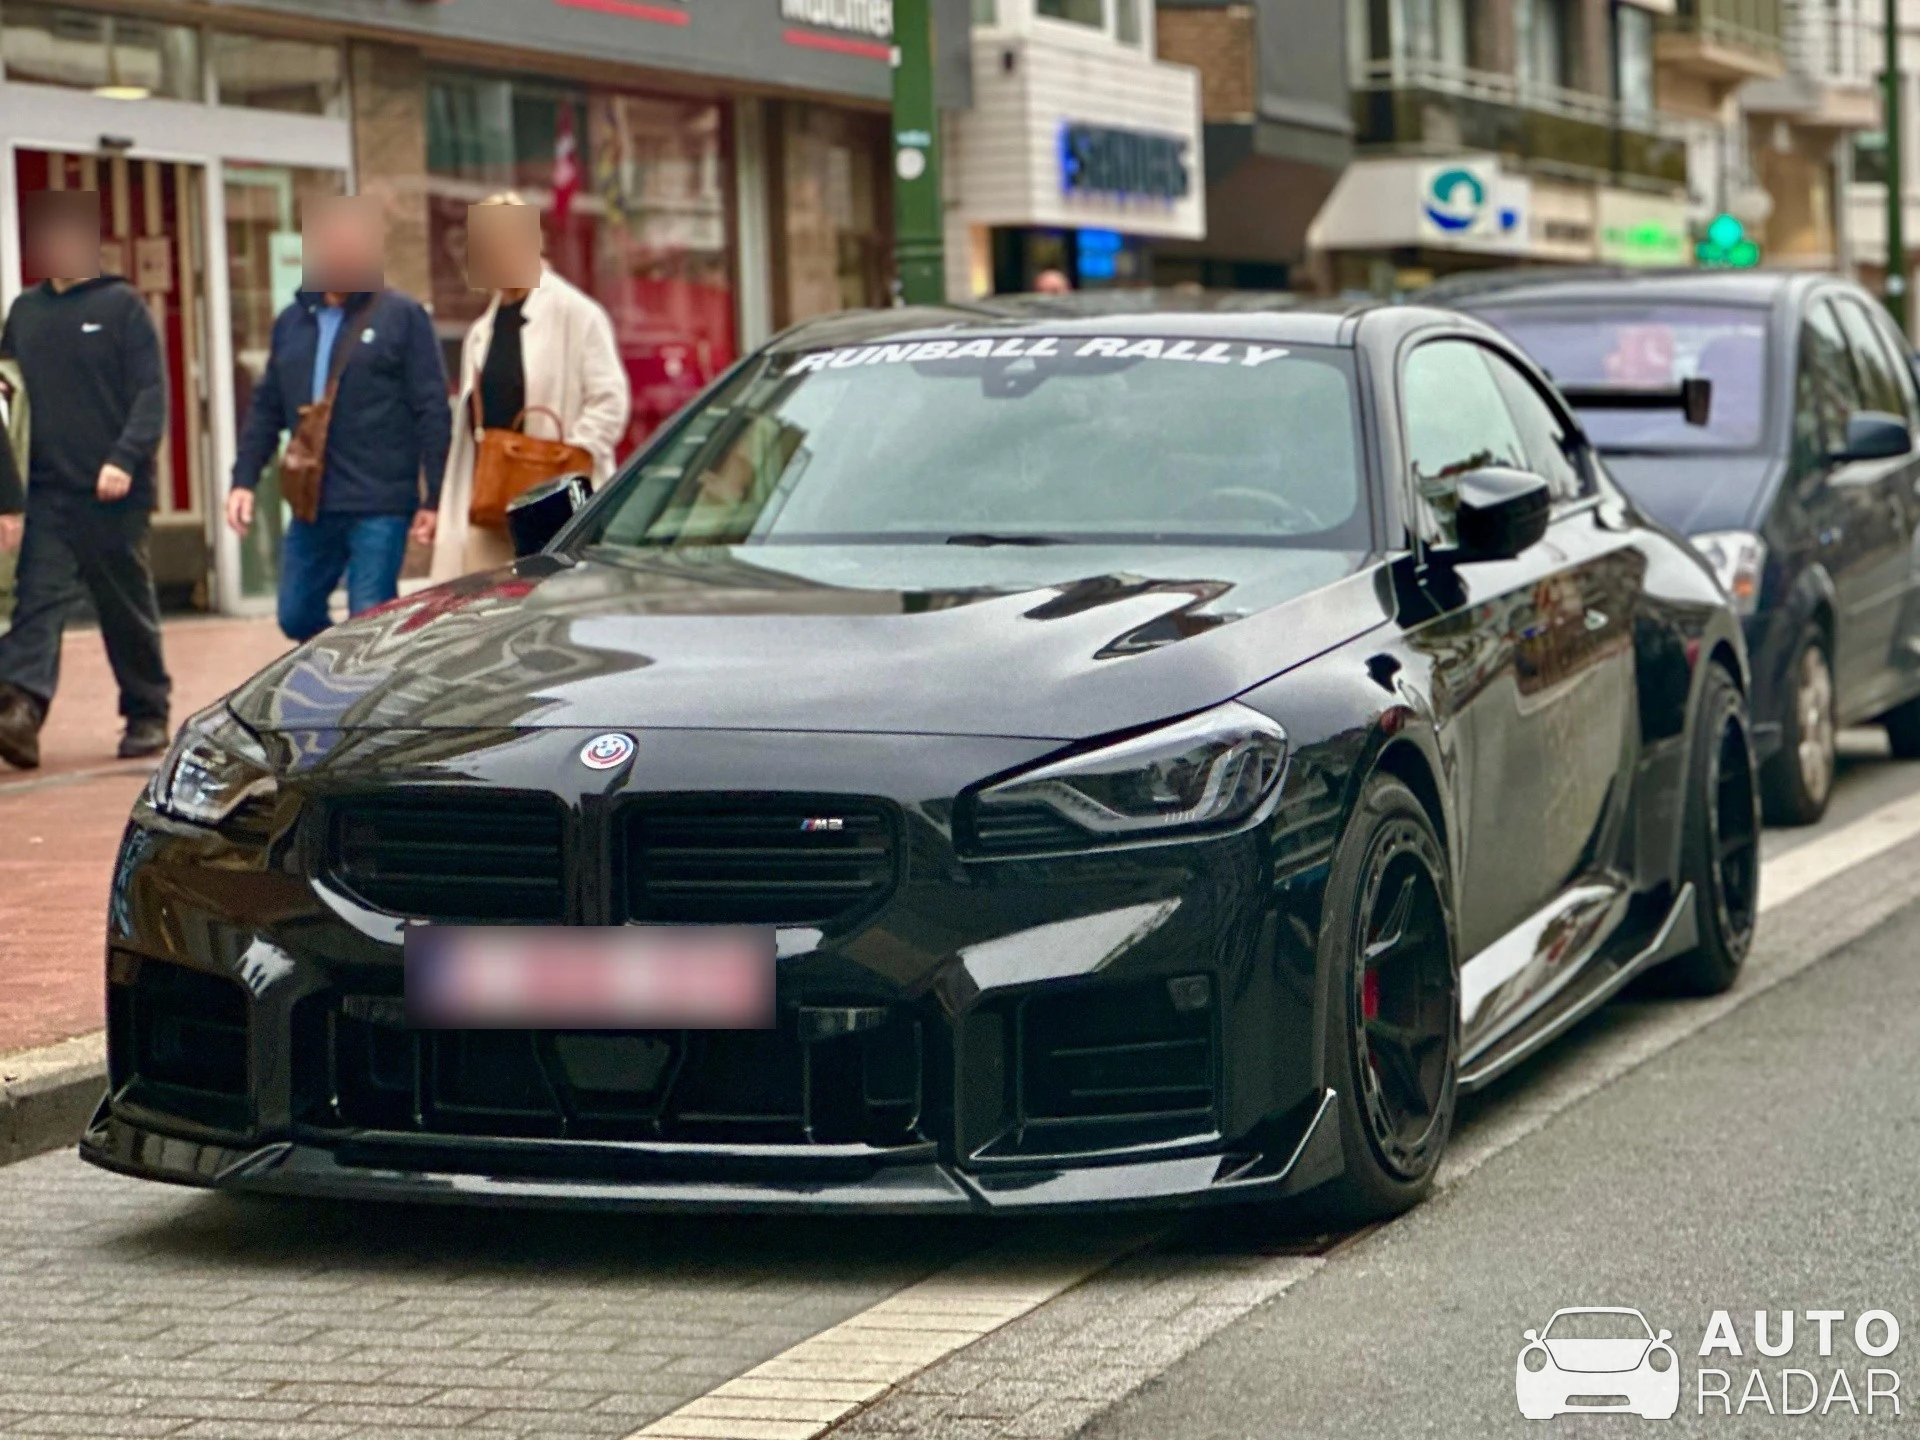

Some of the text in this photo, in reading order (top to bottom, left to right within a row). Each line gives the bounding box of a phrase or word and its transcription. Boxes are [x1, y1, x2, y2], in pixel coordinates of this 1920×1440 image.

[785, 337, 1291, 376] RUNBALL RALLY
[811, 818, 843, 831] M2
